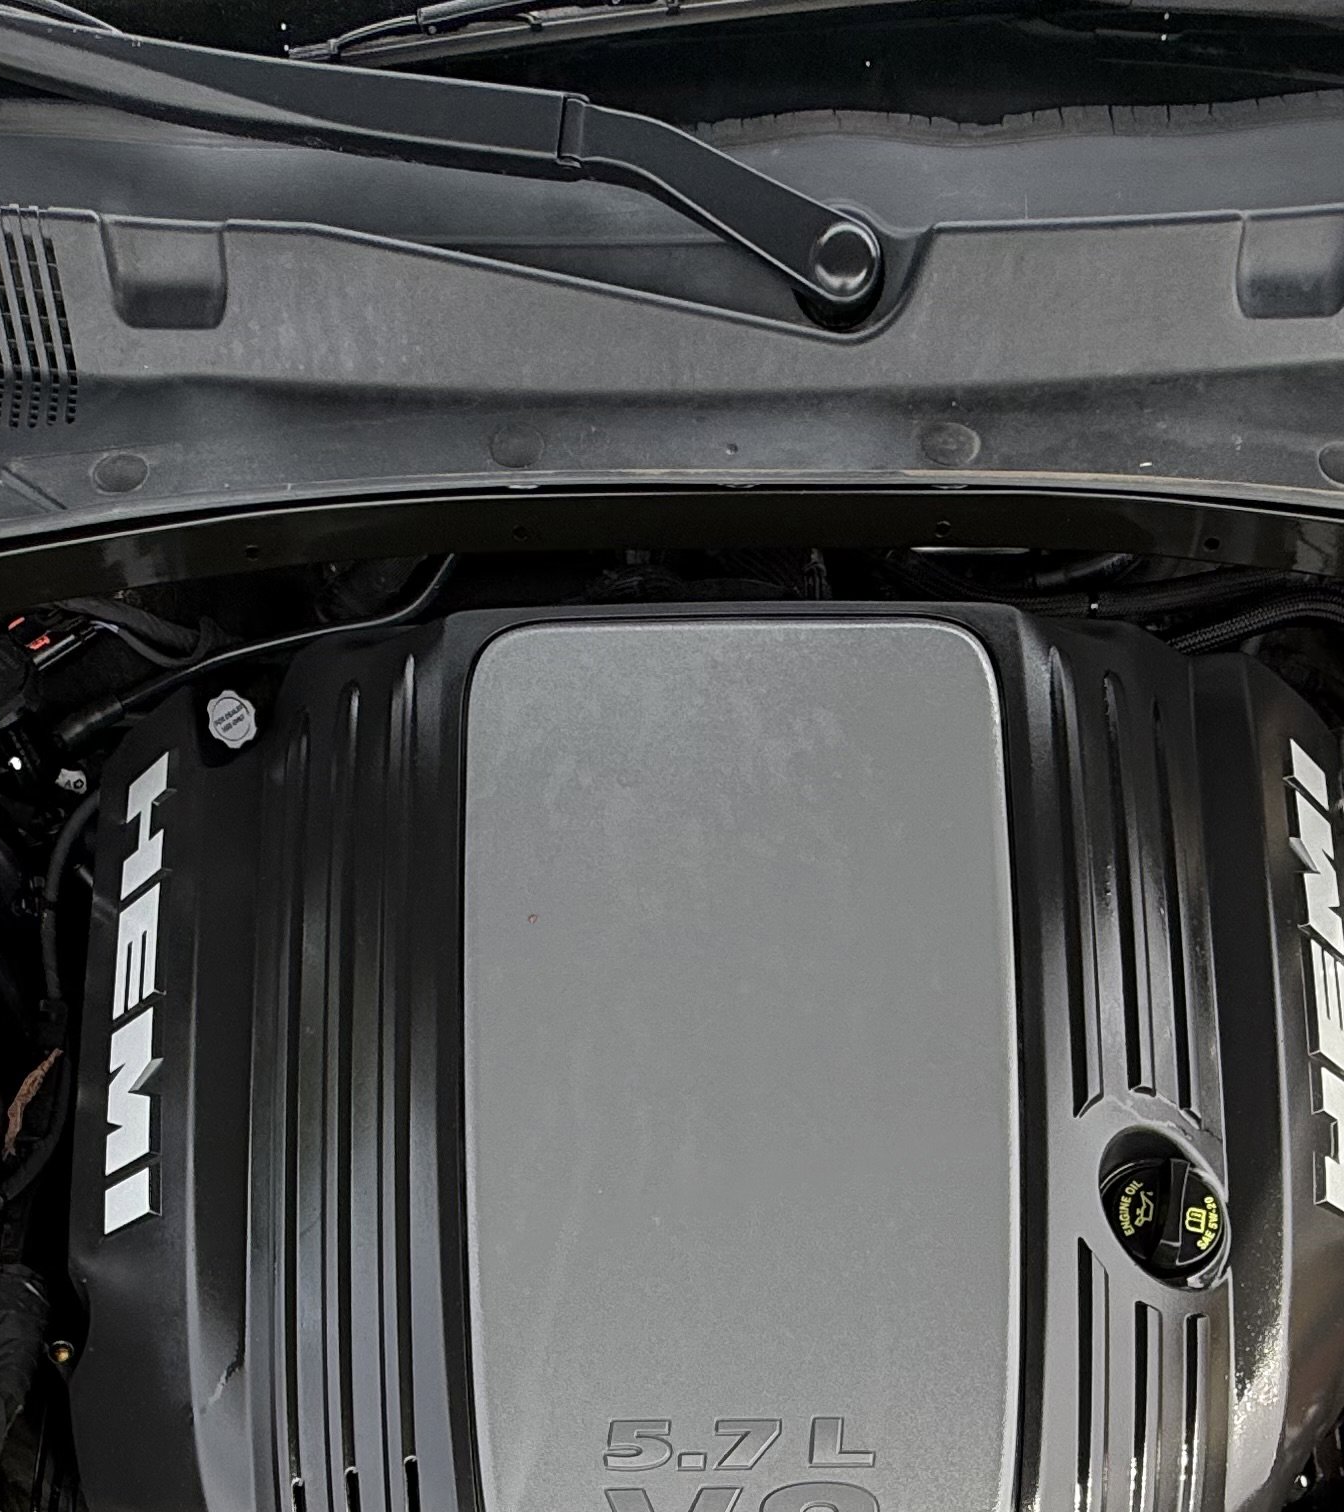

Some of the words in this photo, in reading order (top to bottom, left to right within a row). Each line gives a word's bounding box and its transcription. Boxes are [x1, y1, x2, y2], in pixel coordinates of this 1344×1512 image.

[104, 751, 170, 1236] HEMI
[1124, 1180, 1144, 1195] OIL
[1119, 1195, 1135, 1237] ENGINE
[1203, 1196, 1219, 1230] 5W-20
[1196, 1229, 1216, 1250] SAE
[603, 1418, 782, 1472] 5.7
[808, 1416, 876, 1468] L
